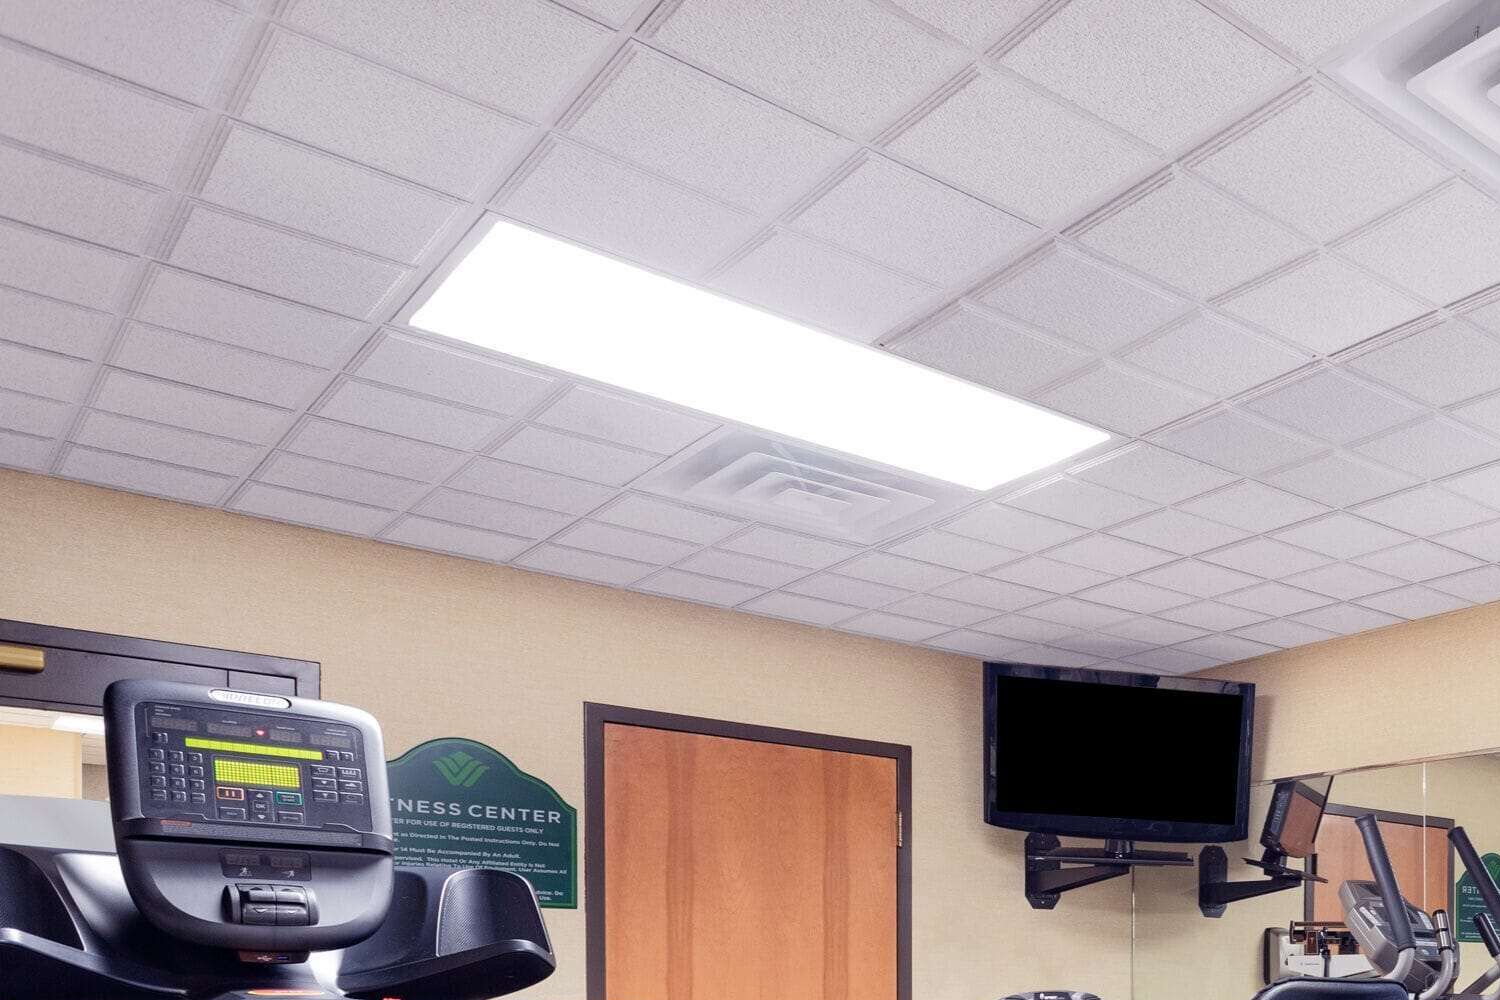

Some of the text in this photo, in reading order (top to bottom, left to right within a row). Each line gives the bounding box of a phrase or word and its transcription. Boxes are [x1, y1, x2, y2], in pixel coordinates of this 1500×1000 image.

[467, 804, 561, 824] CENTER
[451, 822, 496, 831] REGISTERED
[497, 825, 523, 833] GUESTS
